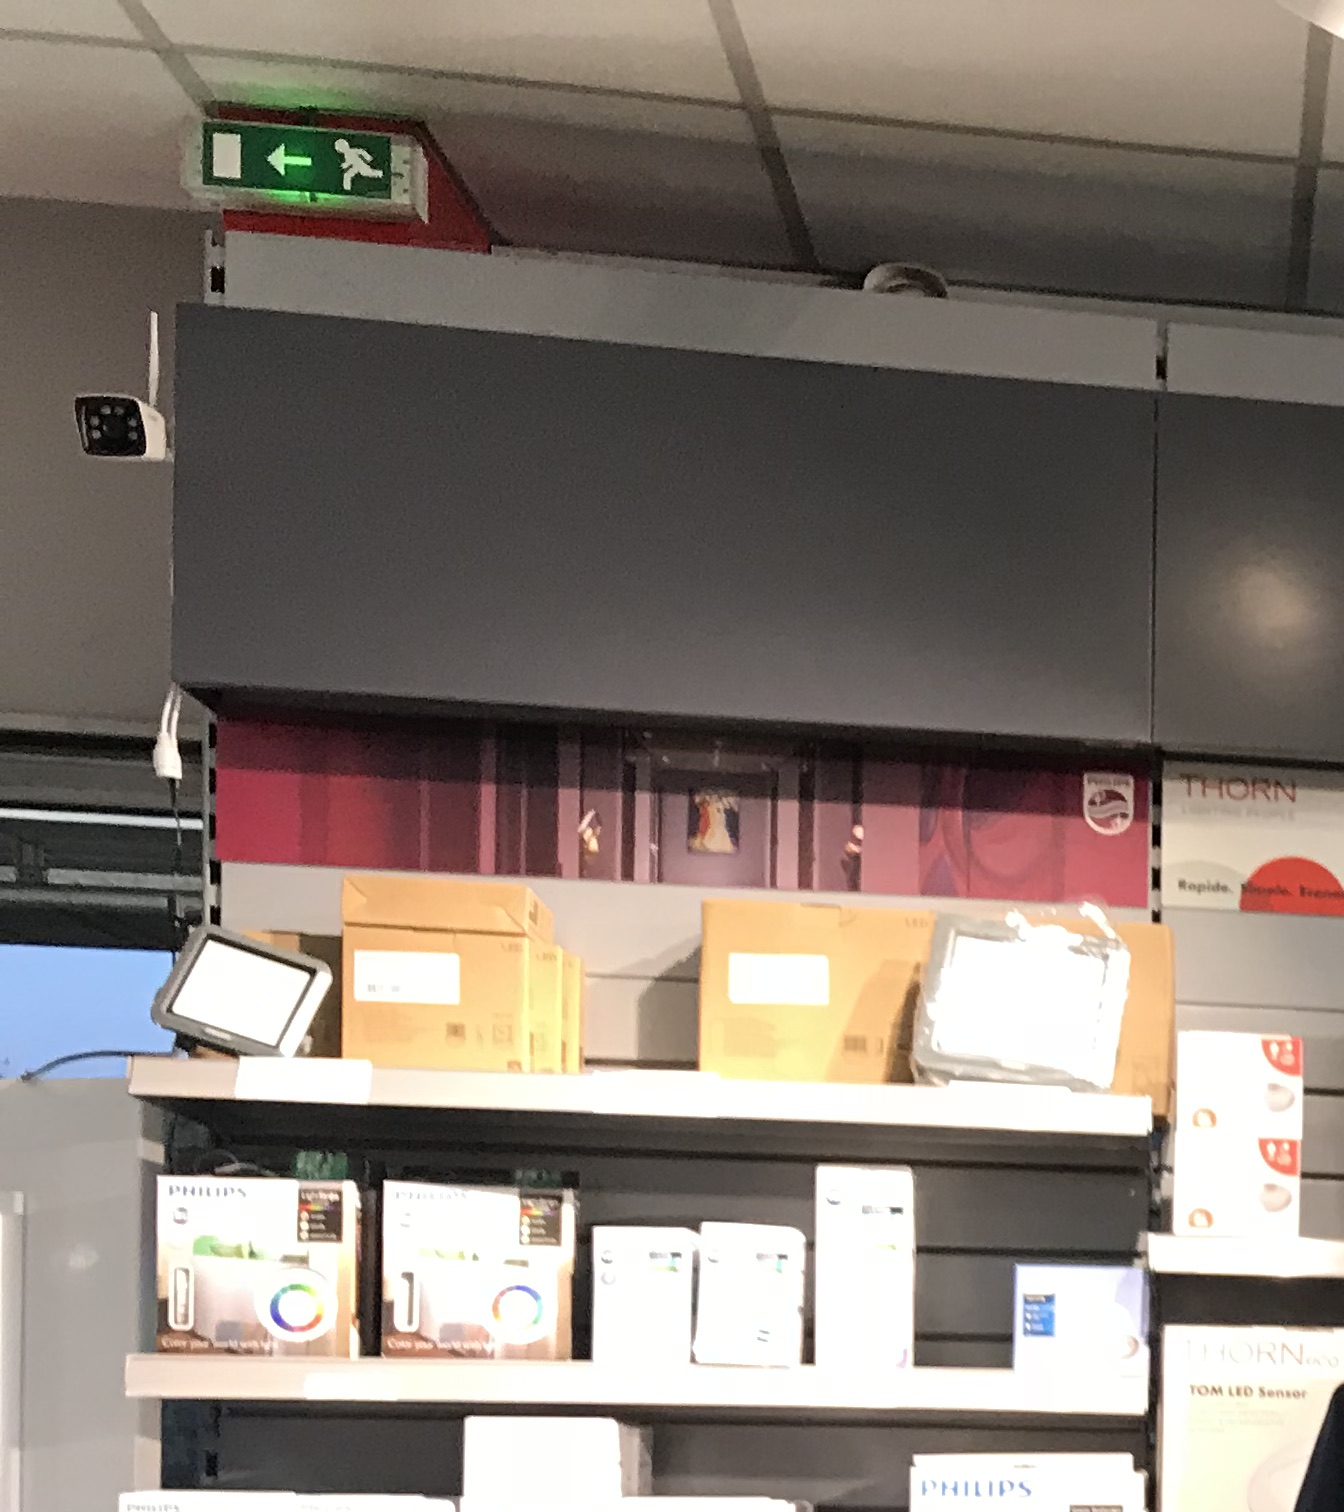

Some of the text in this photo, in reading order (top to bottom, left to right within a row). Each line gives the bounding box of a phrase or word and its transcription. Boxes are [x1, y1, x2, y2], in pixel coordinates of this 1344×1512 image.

[1179, 773, 1298, 803] THORN
[168, 1184, 248, 1198] PHILIPS
[1189, 1384, 1308, 1400] TOM LED Sensor
[921, 1479, 1032, 1497] PHILIPS
